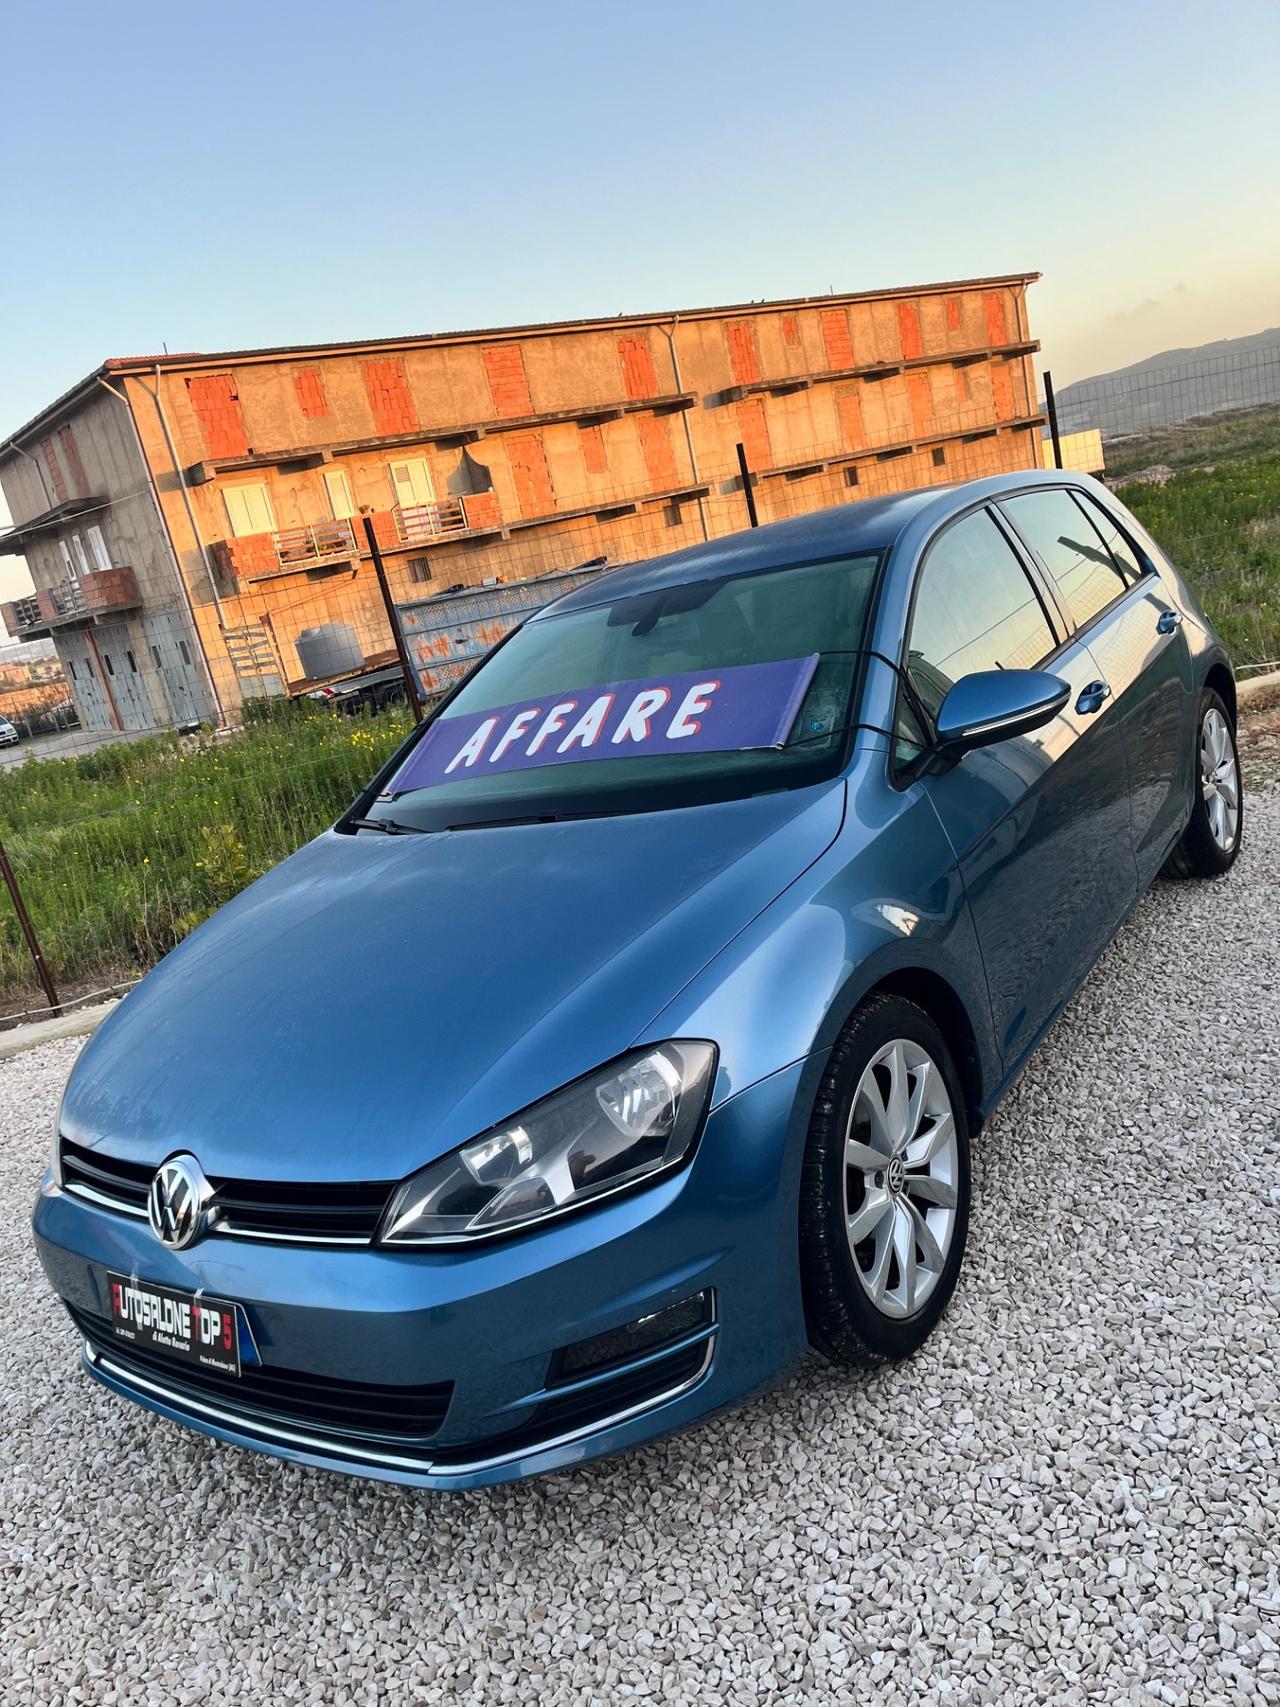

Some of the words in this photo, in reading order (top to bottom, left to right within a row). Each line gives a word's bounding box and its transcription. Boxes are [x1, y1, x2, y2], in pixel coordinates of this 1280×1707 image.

[444, 680, 721, 774] AFFARE
[111, 1283, 191, 1339] AUTOSALONE
[192, 1304, 221, 1346] TOP
[222, 1313, 232, 1350] 5
